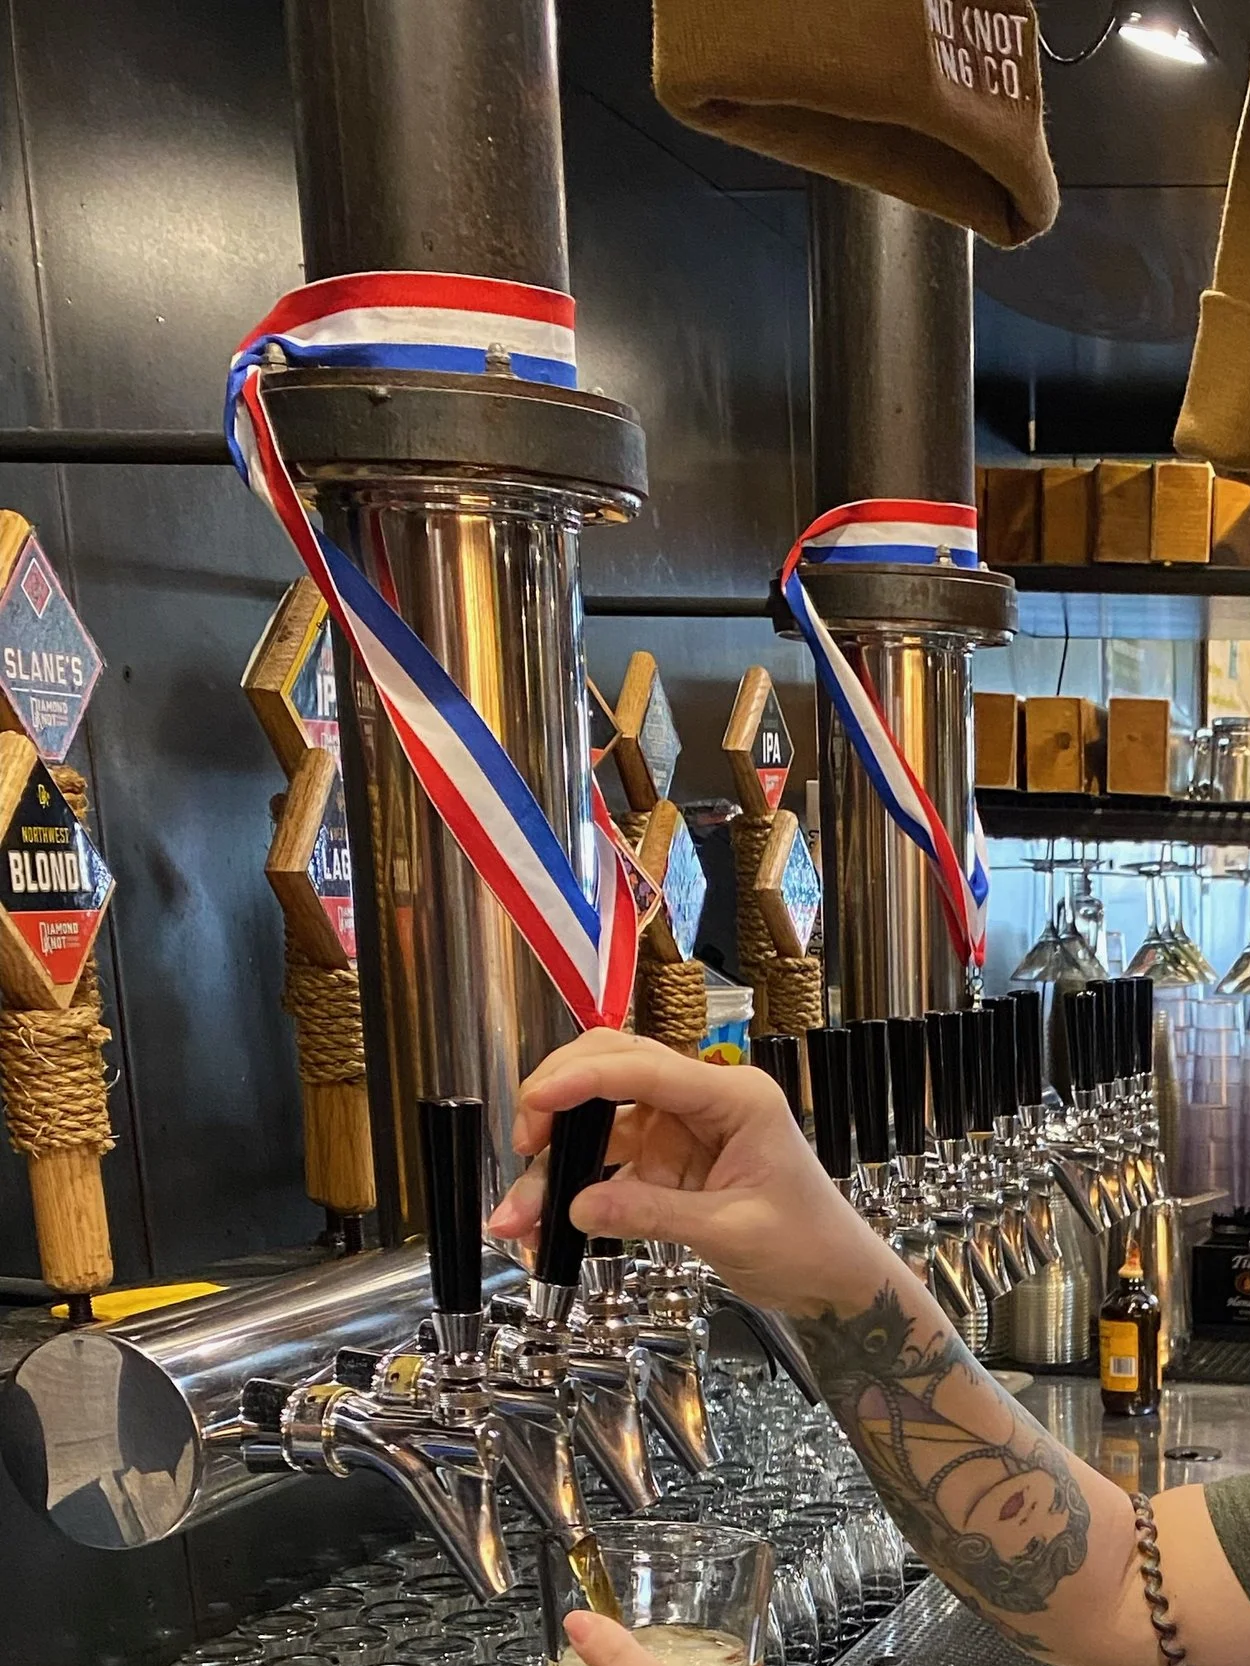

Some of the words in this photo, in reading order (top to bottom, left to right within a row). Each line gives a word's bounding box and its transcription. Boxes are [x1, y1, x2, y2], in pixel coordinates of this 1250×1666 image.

[984, 56, 1030, 100] CO.
[4, 647, 83, 687] SLANE'S
[30, 696, 68, 721] DIAMOND
[316, 673, 338, 718] IP
[762, 731, 781, 764] IPA
[22, 826, 70, 844] NORTHWEST
[39, 921, 79, 945] DIAMOND
